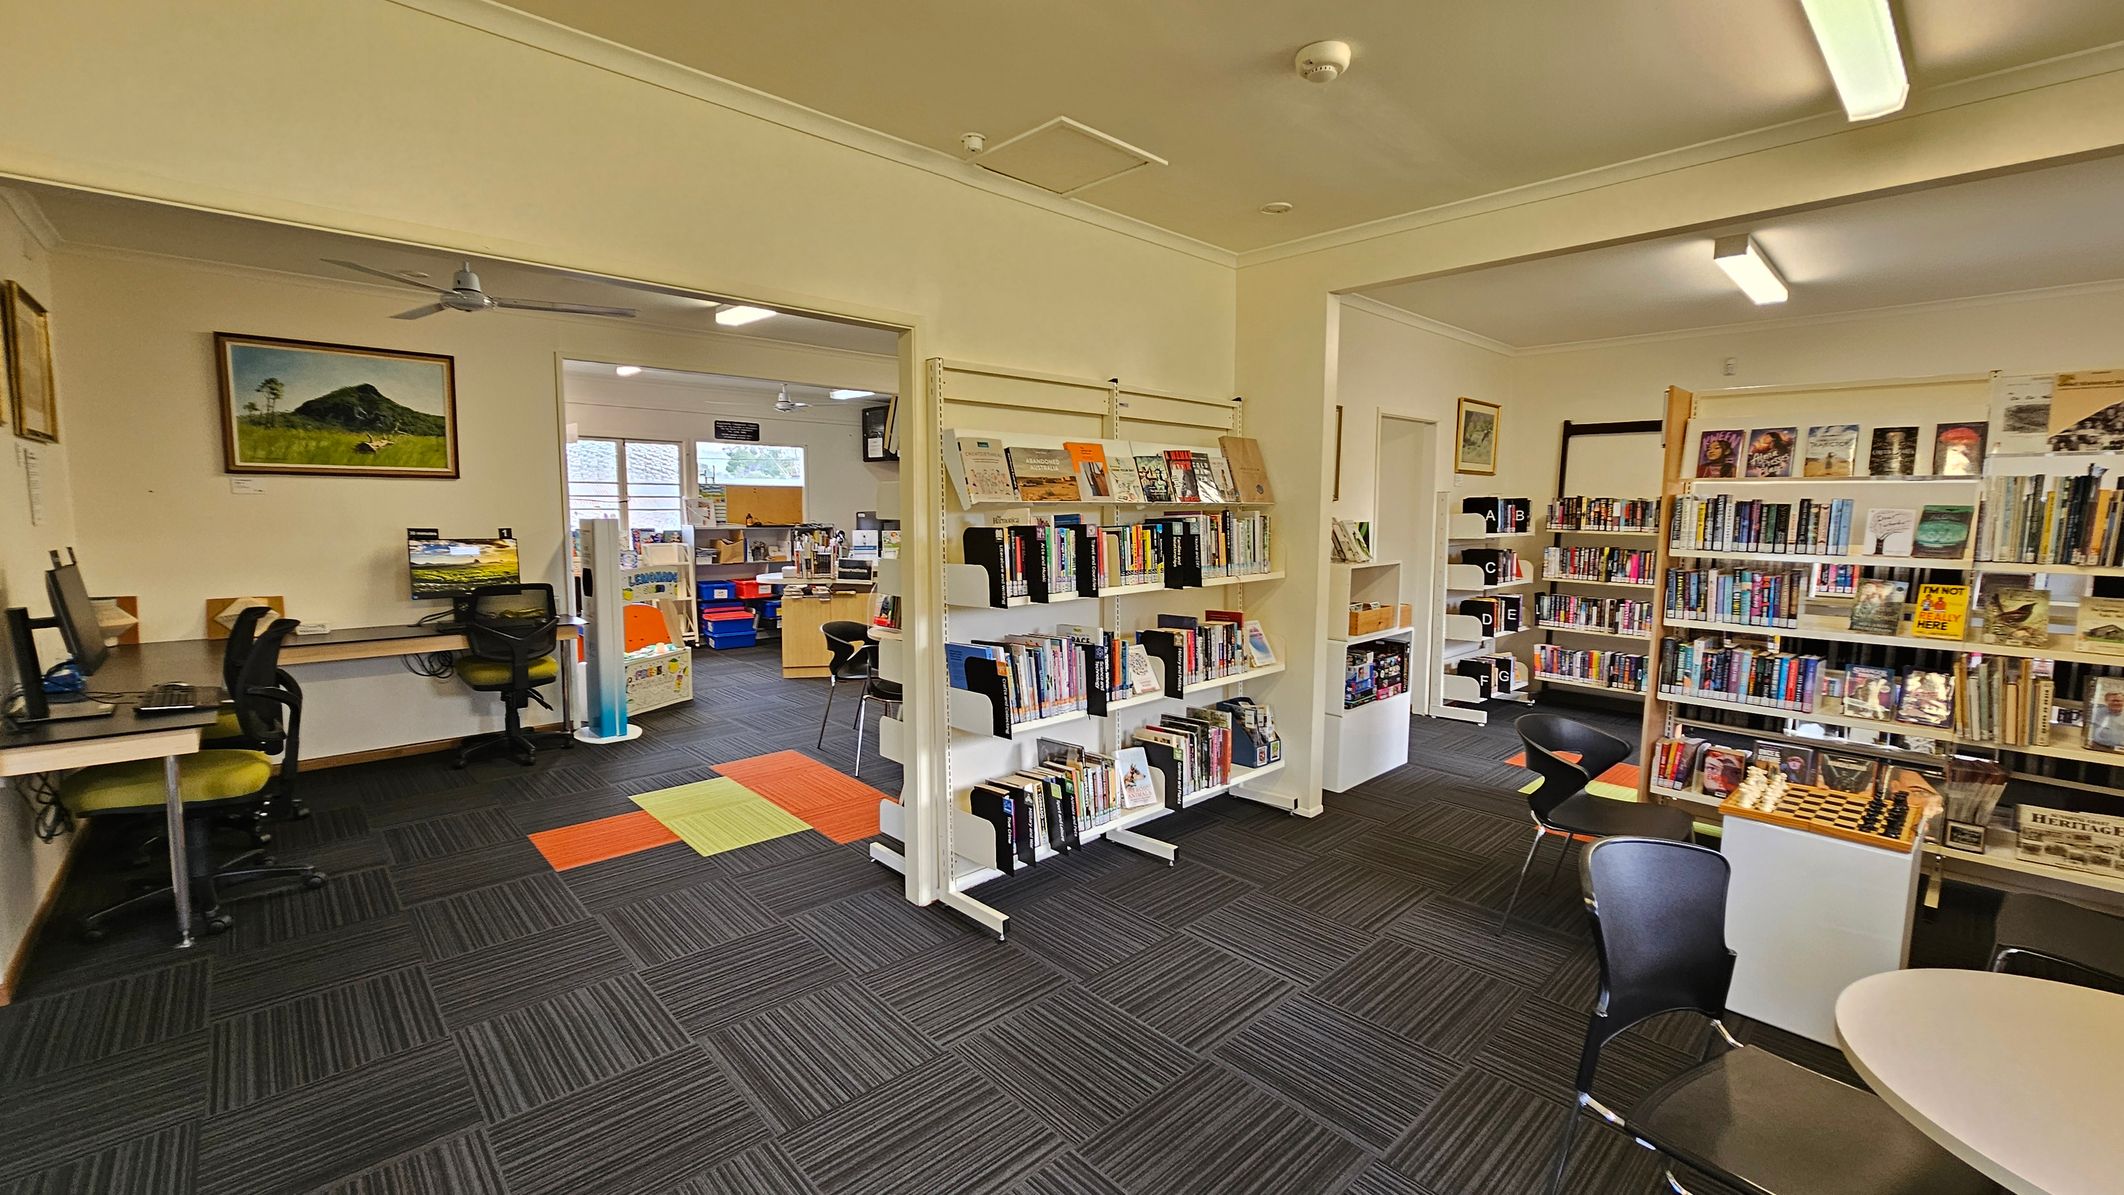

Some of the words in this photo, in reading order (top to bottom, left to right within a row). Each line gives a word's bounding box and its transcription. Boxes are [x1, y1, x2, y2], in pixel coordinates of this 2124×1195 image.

[1025, 457, 1060, 465] ABANDONED
[1485, 509, 1497, 522] A
[1515, 510, 1525, 521] B
[502, 529, 508, 537] 1
[1485, 561, 1497, 574] C
[1922, 586, 1939, 595] I'M
[1941, 587, 1967, 596] NOT
[1482, 613, 1493, 625] D
[1507, 609, 1518, 621] E
[1919, 611, 1962, 622] REALLY
[1917, 620, 1949, 631] HERE
[1066, 635, 1090, 643] PACE
[1480, 675, 1490, 687] F
[1498, 670, 1510, 682] G
[2031, 812, 2124, 837] HERITAGE
